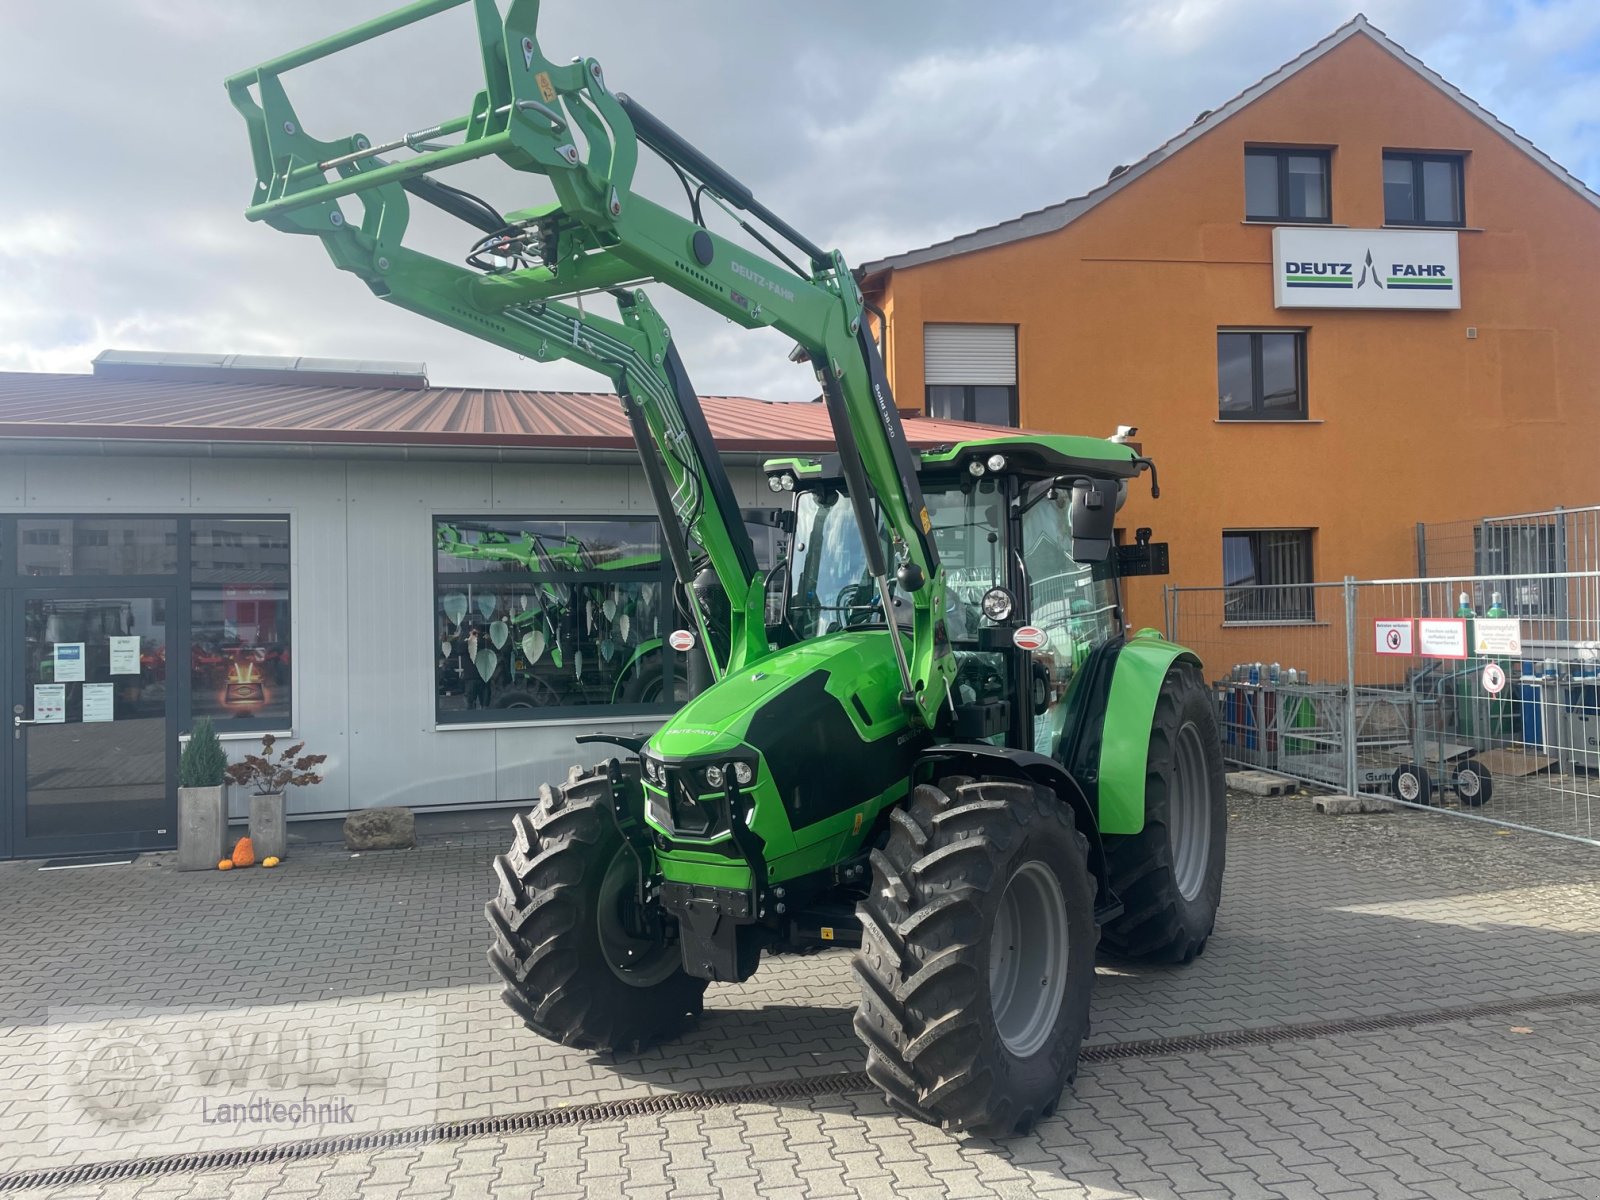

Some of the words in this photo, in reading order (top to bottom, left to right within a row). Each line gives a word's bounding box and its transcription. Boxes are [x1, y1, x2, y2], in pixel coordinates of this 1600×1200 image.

[731, 260, 795, 303] DEUTZ-FAHR
[1286, 262, 1353, 275] DEUTZ
[1392, 264, 1446, 277] FAHR
[874, 383, 887, 410] Solid
[883, 410, 896, 438] 38-20
